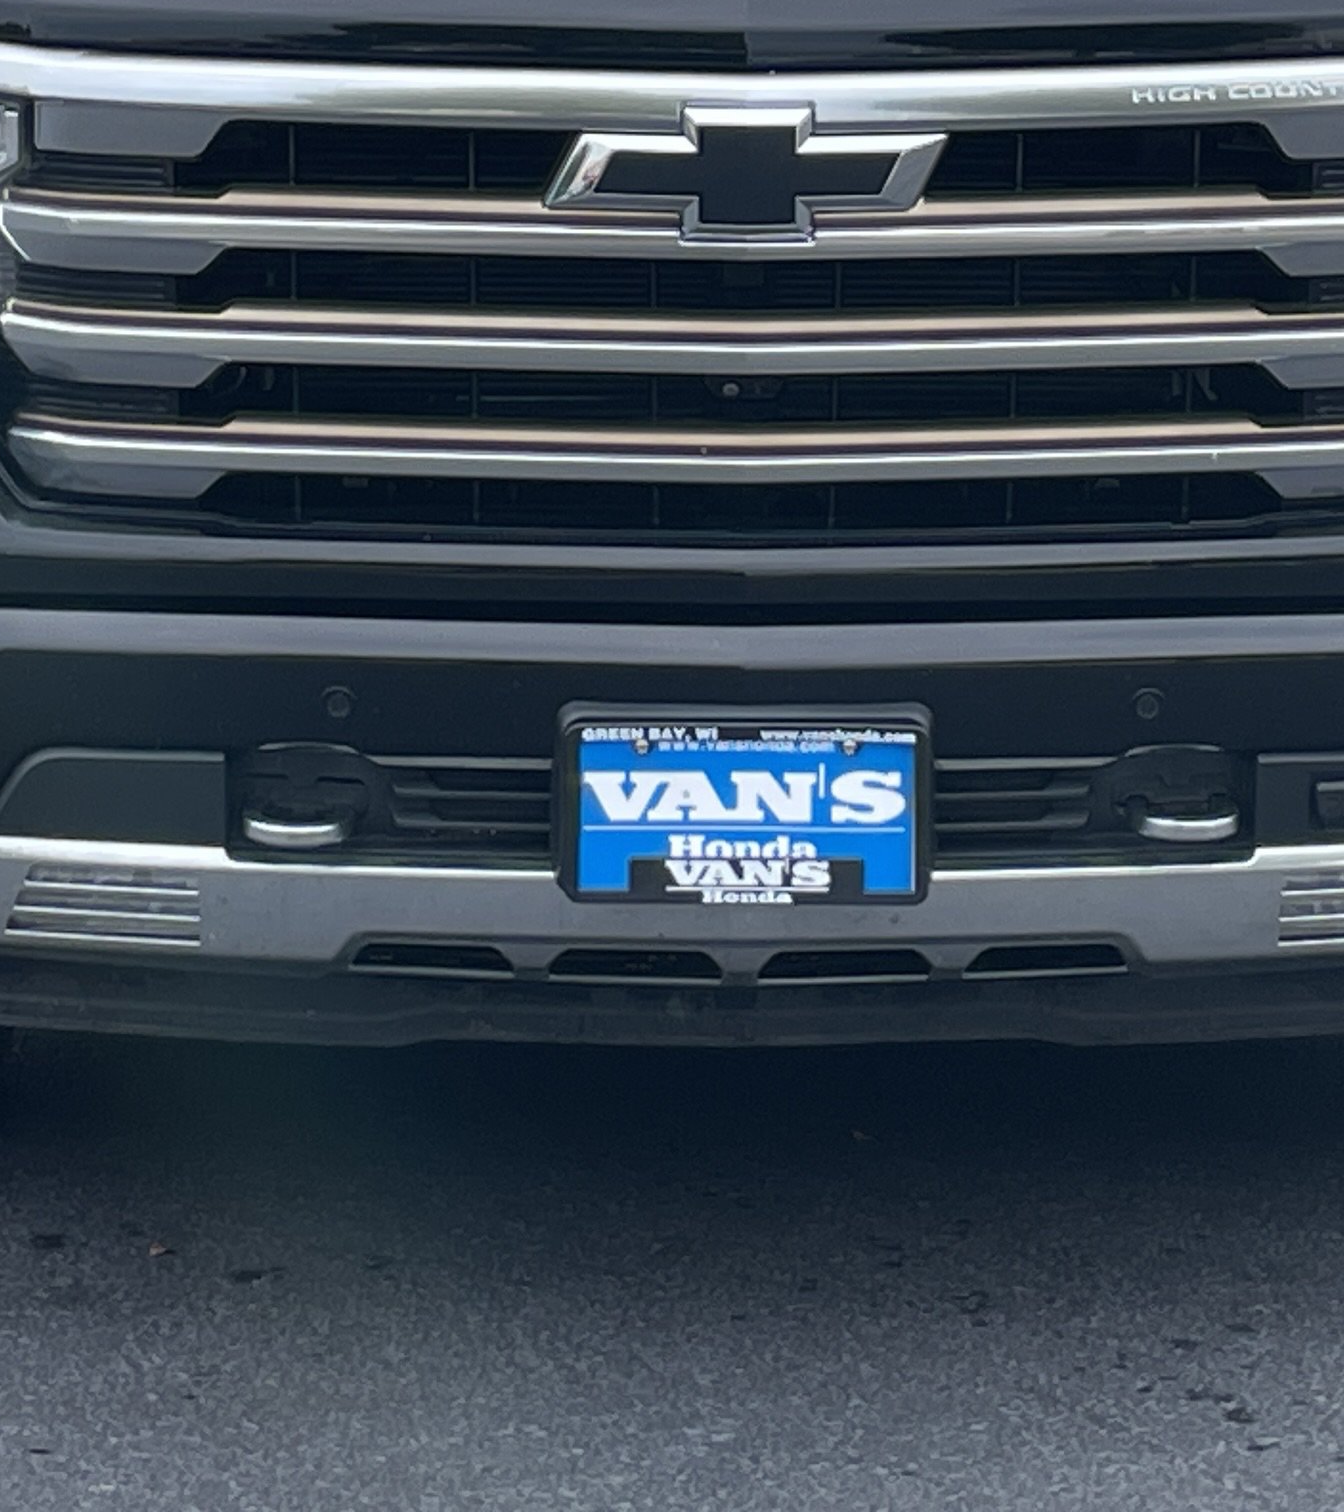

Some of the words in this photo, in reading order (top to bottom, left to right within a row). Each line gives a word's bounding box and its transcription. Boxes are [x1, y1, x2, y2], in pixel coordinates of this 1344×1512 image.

[1131, 85, 1217, 104] HIGH
[581, 727, 644, 741] GREEN
[648, 726, 690, 743] BAY,
[694, 726, 718, 740] WI
[583, 762, 906, 824] VAN'S
[668, 834, 818, 858] Honda
[665, 856, 831, 886] VAN'S
[702, 889, 793, 904] Honda
